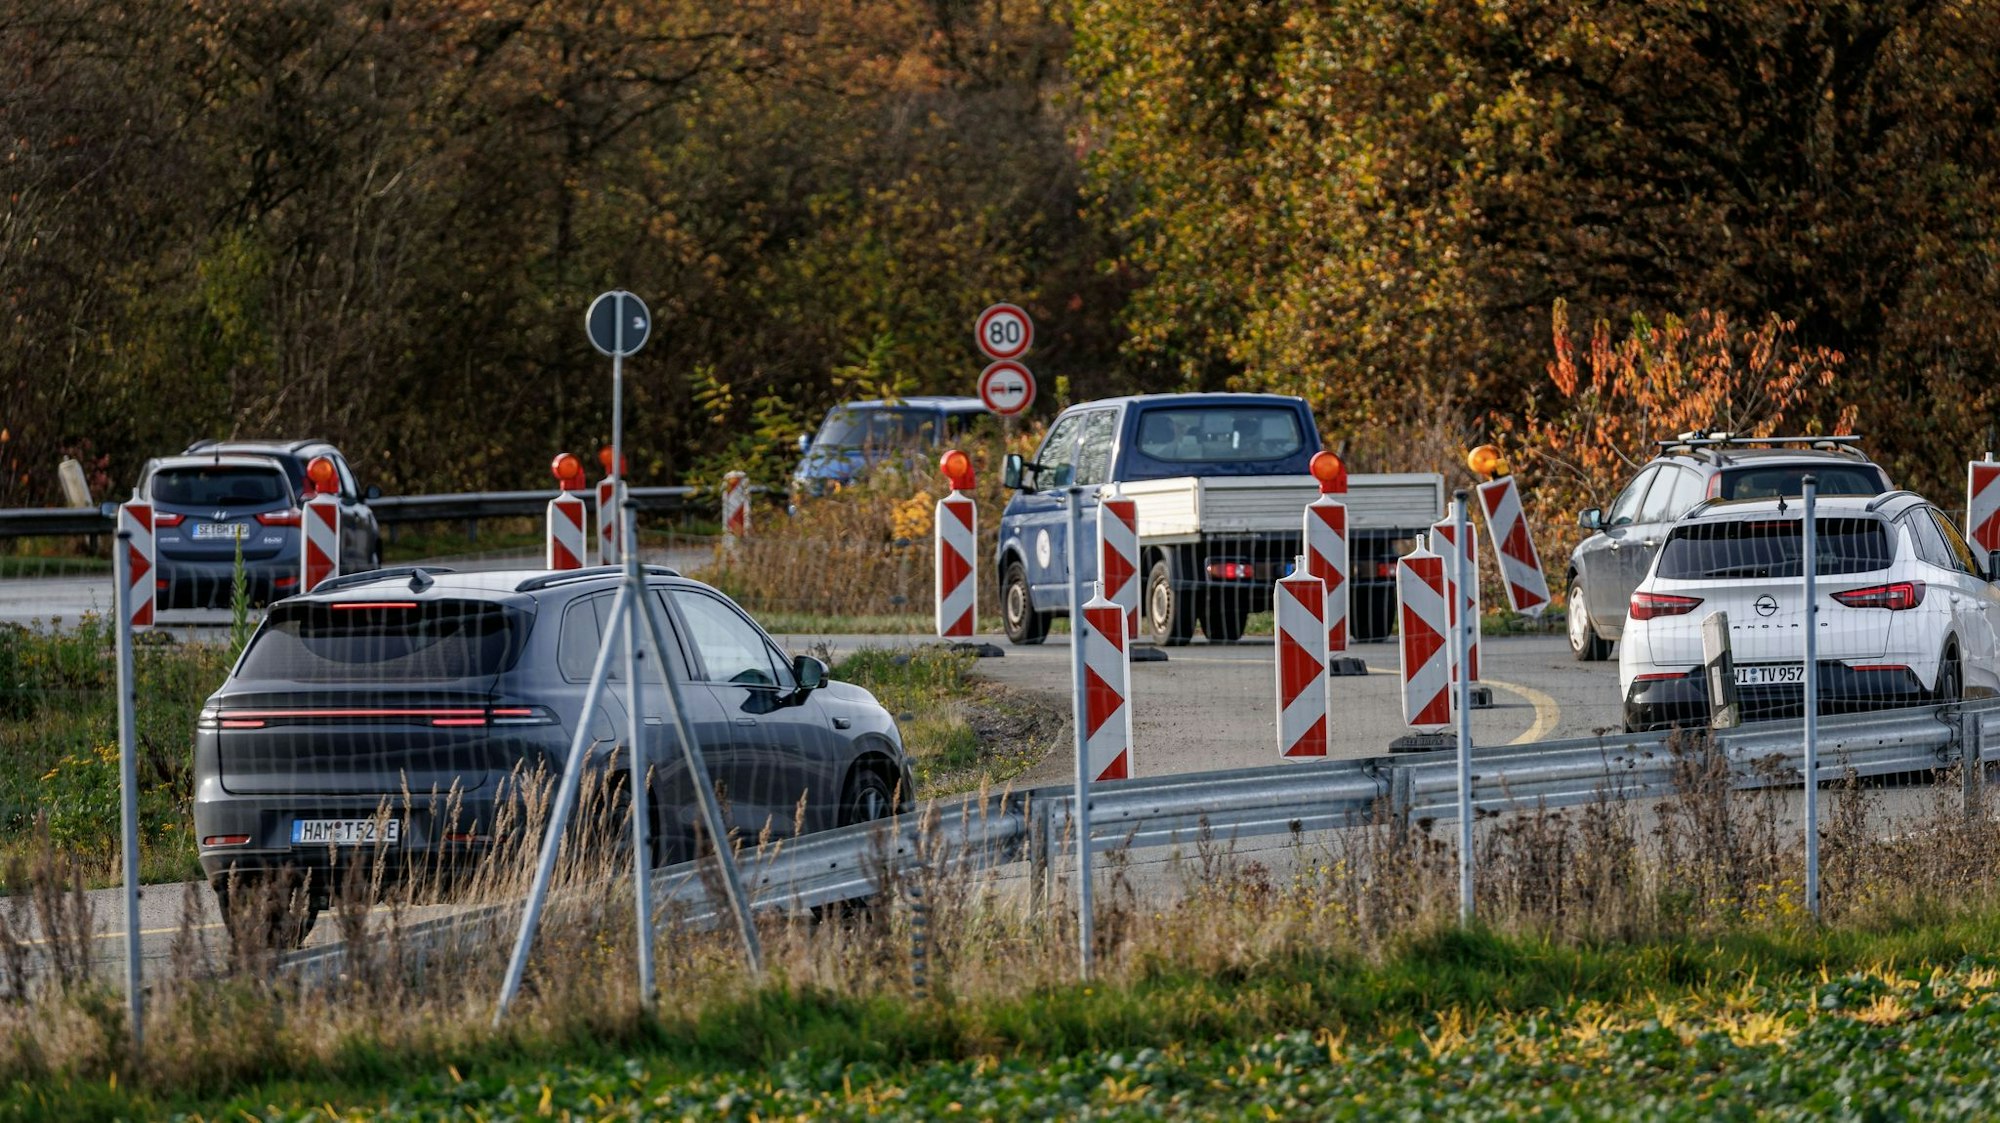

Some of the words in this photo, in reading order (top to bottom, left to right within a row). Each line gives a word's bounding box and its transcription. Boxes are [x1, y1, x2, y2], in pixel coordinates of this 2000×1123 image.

[990, 320, 1020, 344] 80
[1759, 667, 1776, 682] TV
[1779, 666, 1804, 682] 957
[304, 821, 334, 840] HAM
[344, 821, 354, 840] T
[356, 821, 397, 840] 52E
